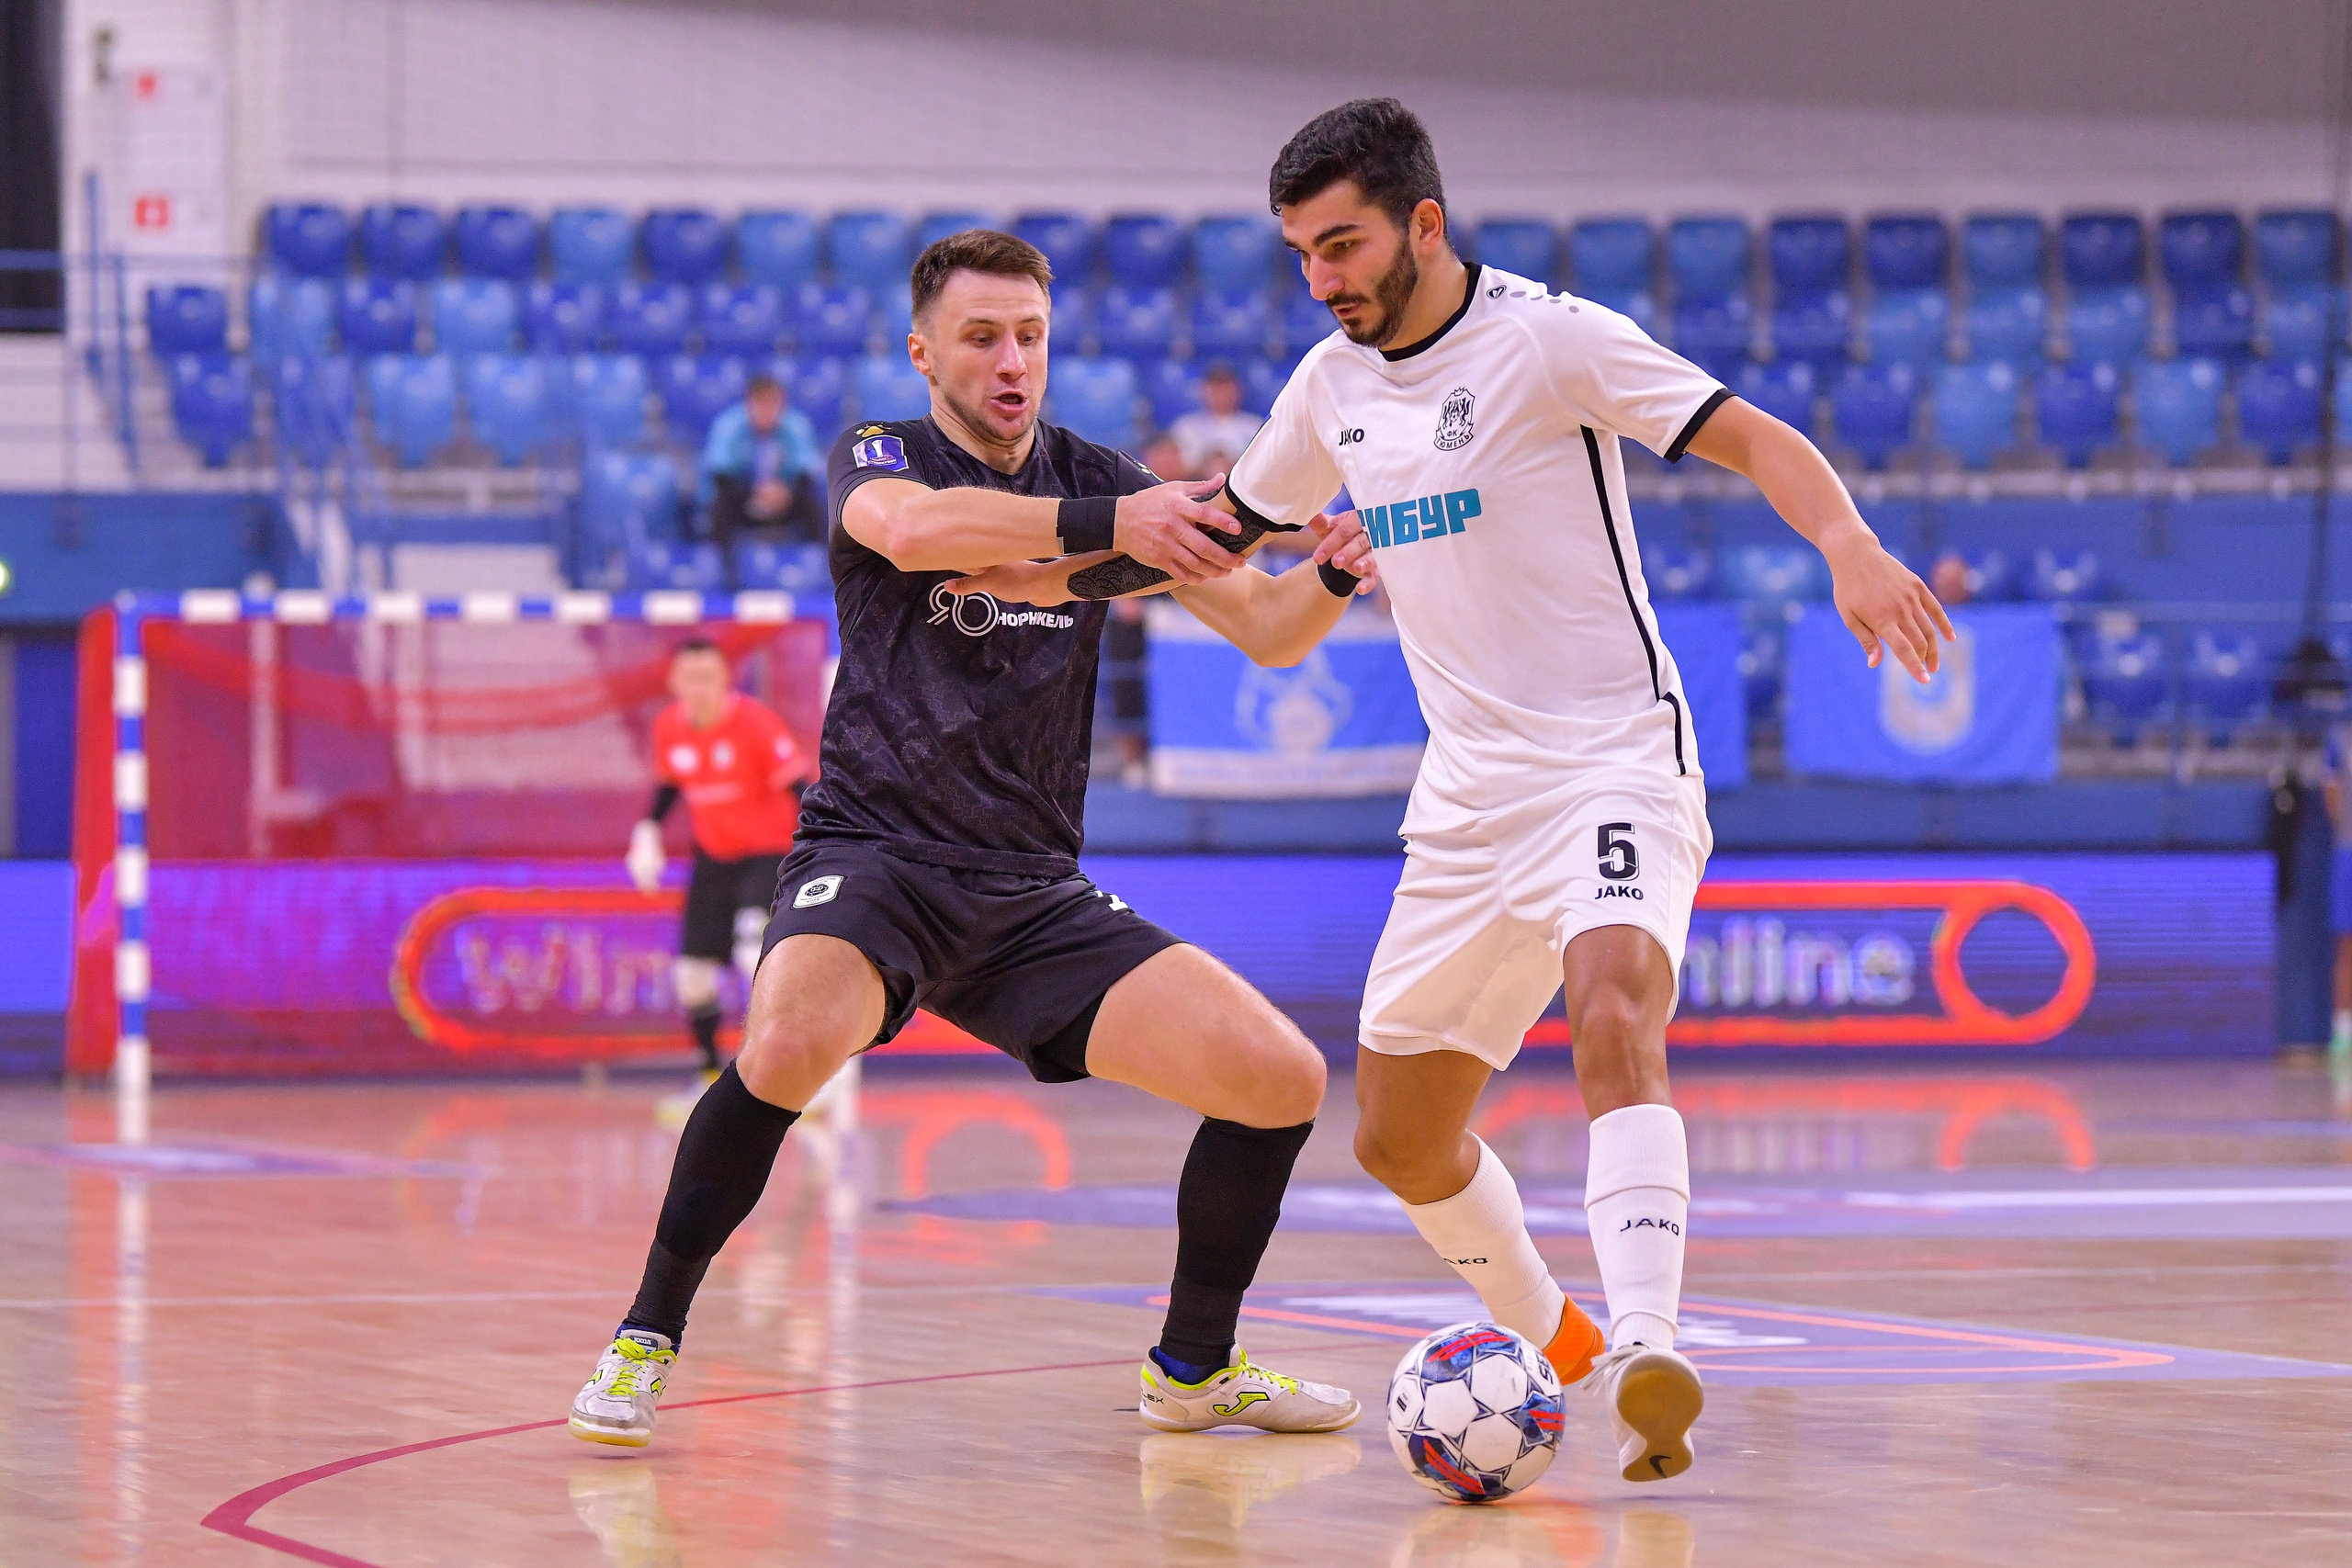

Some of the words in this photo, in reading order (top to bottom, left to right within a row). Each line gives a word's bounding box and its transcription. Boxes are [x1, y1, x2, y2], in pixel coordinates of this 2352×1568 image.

[1339, 428, 1365, 446] JAKO
[1435, 434, 1470, 449] ТЮМЕНЬ
[997, 611, 1074, 629] НОРНКЕЛЬ
[1597, 822, 1640, 882] 5
[1594, 885, 1645, 901] JAKO
[1678, 913, 1917, 1010] nline
[1620, 1217, 1679, 1236] JAKO
[1140, 1386, 1165, 1404] LEX
